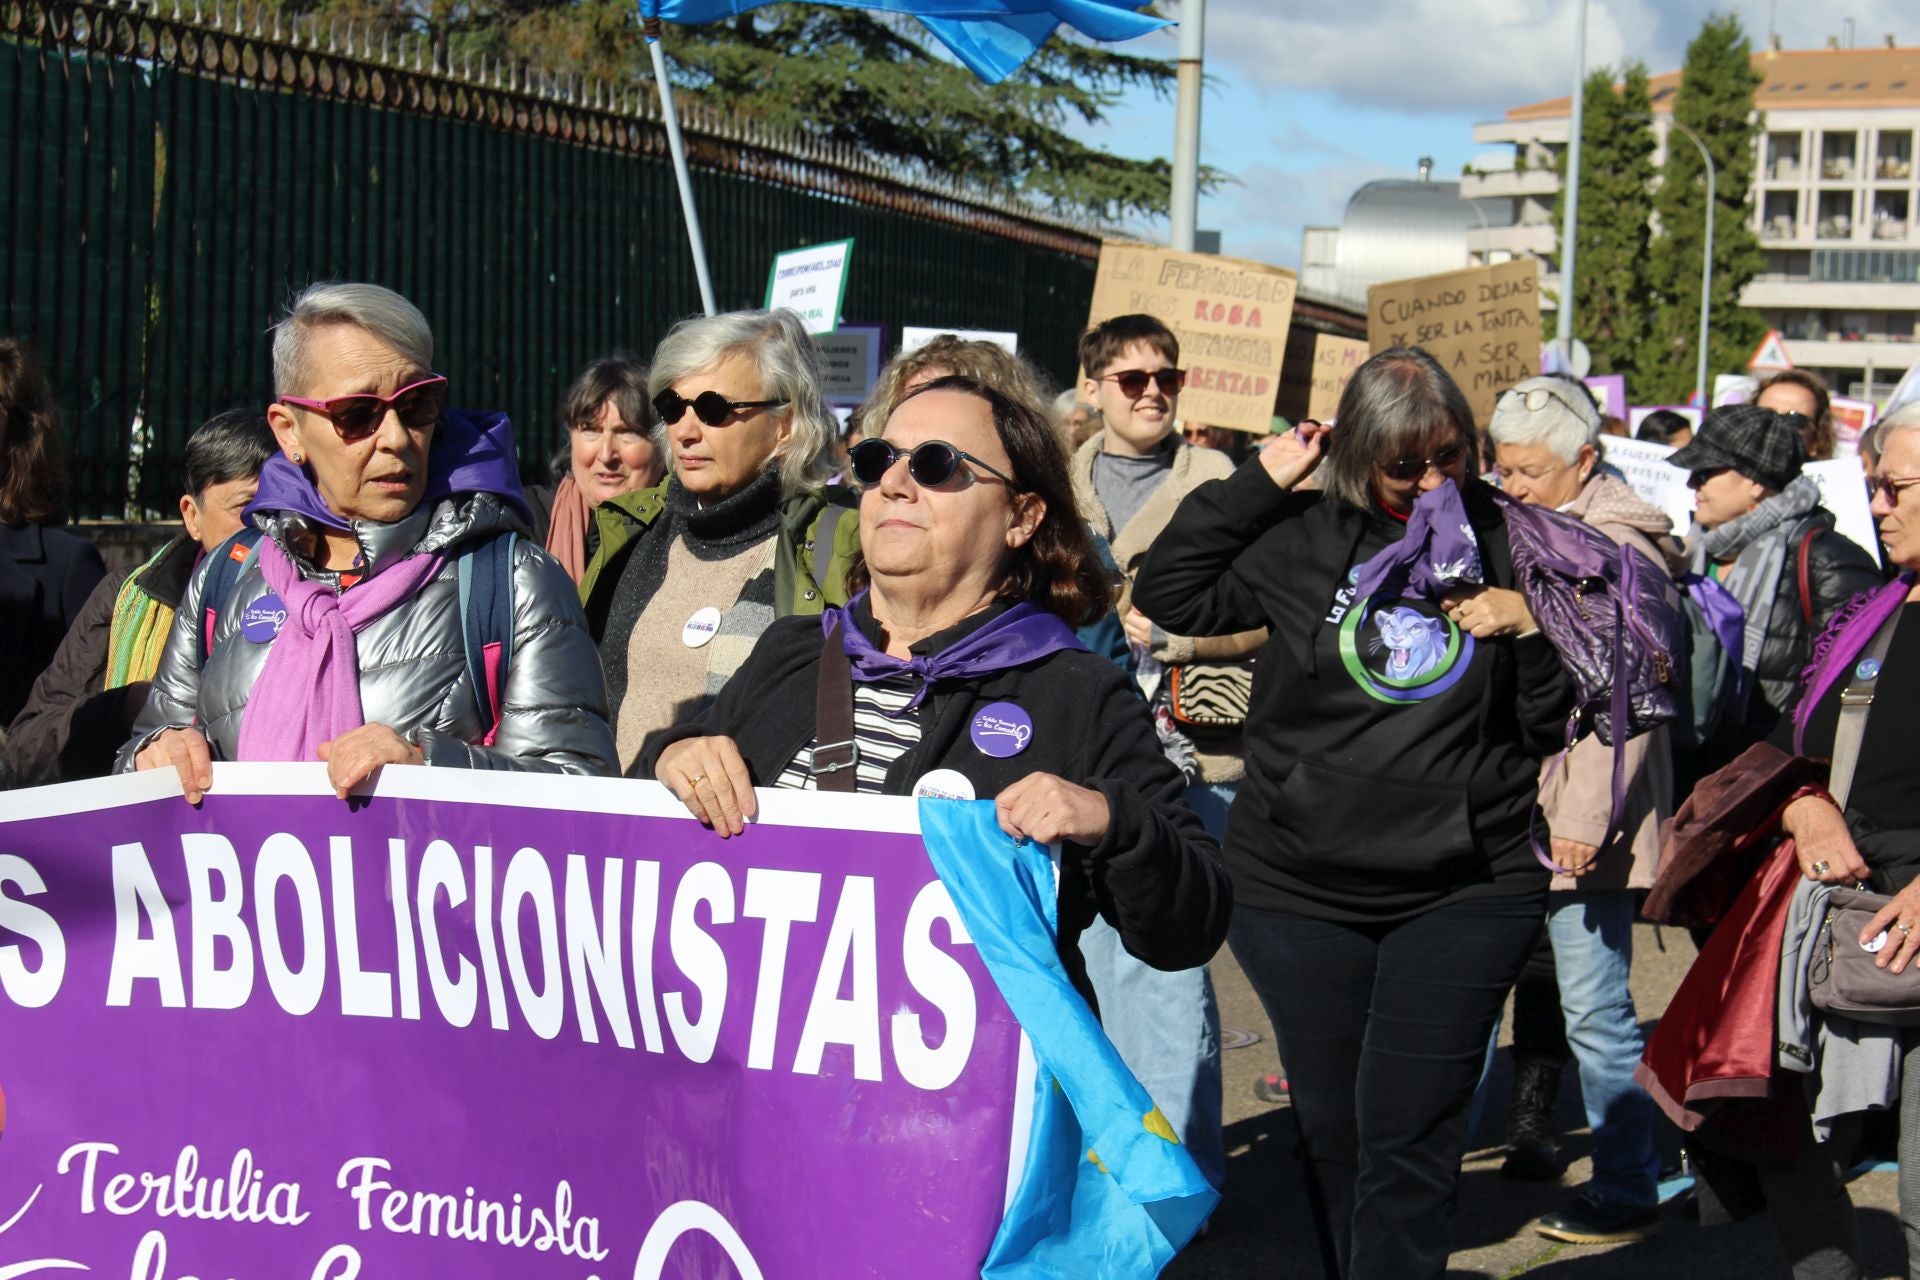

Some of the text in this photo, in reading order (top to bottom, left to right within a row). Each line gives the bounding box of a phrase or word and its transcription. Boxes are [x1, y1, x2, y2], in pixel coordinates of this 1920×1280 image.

[1110, 250, 1146, 282] LA
[1194, 299, 1262, 328] ROBA
[1379, 276, 1533, 325] CUANDO DEJAS
[1416, 321, 1448, 344] SER
[1454, 319, 1473, 335] LA
[1453, 342, 1521, 370] A SER
[1474, 363, 1532, 391] MALA
[106, 832, 978, 1091] ABOLICIONISTAS
[57, 1141, 311, 1226] Tertulia
[337, 1156, 609, 1262] Feminista
